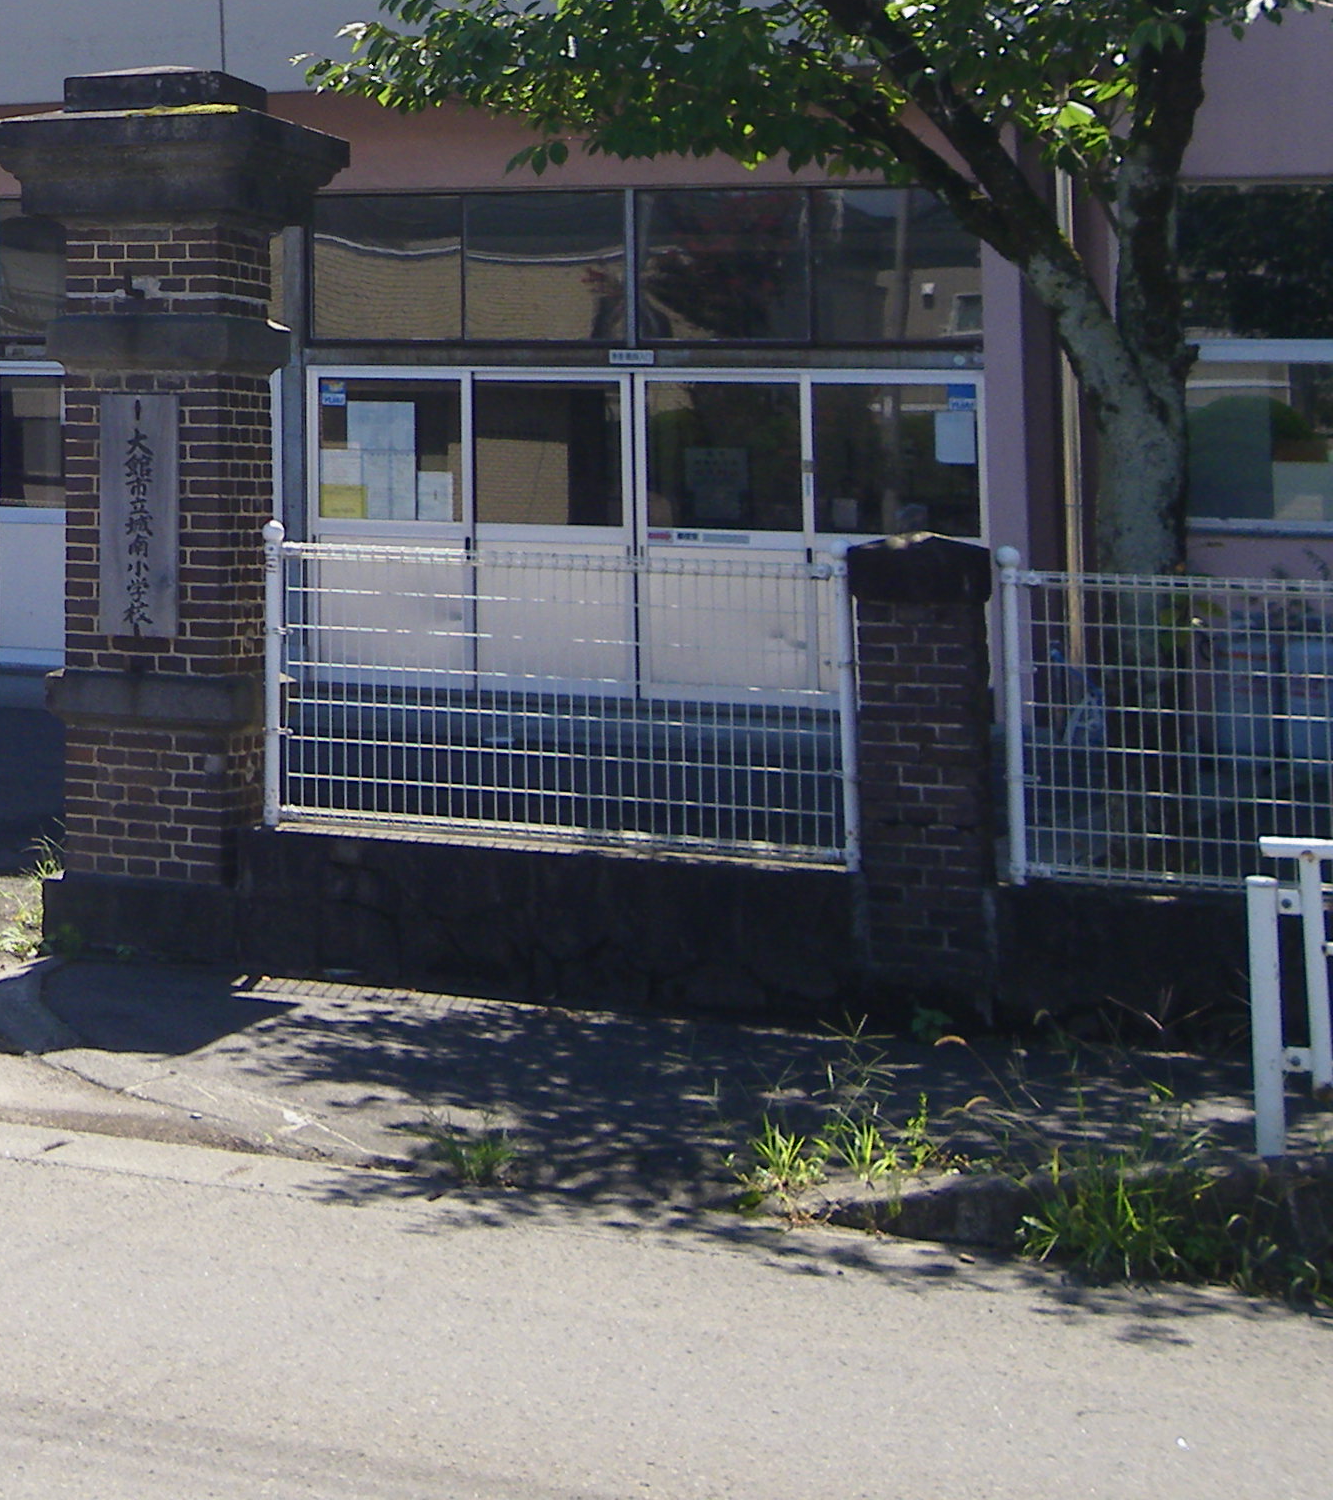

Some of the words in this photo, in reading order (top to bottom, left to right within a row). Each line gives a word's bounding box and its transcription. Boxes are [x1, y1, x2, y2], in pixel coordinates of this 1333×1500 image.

[123, 428, 154, 624] 大館市立城南小学校
